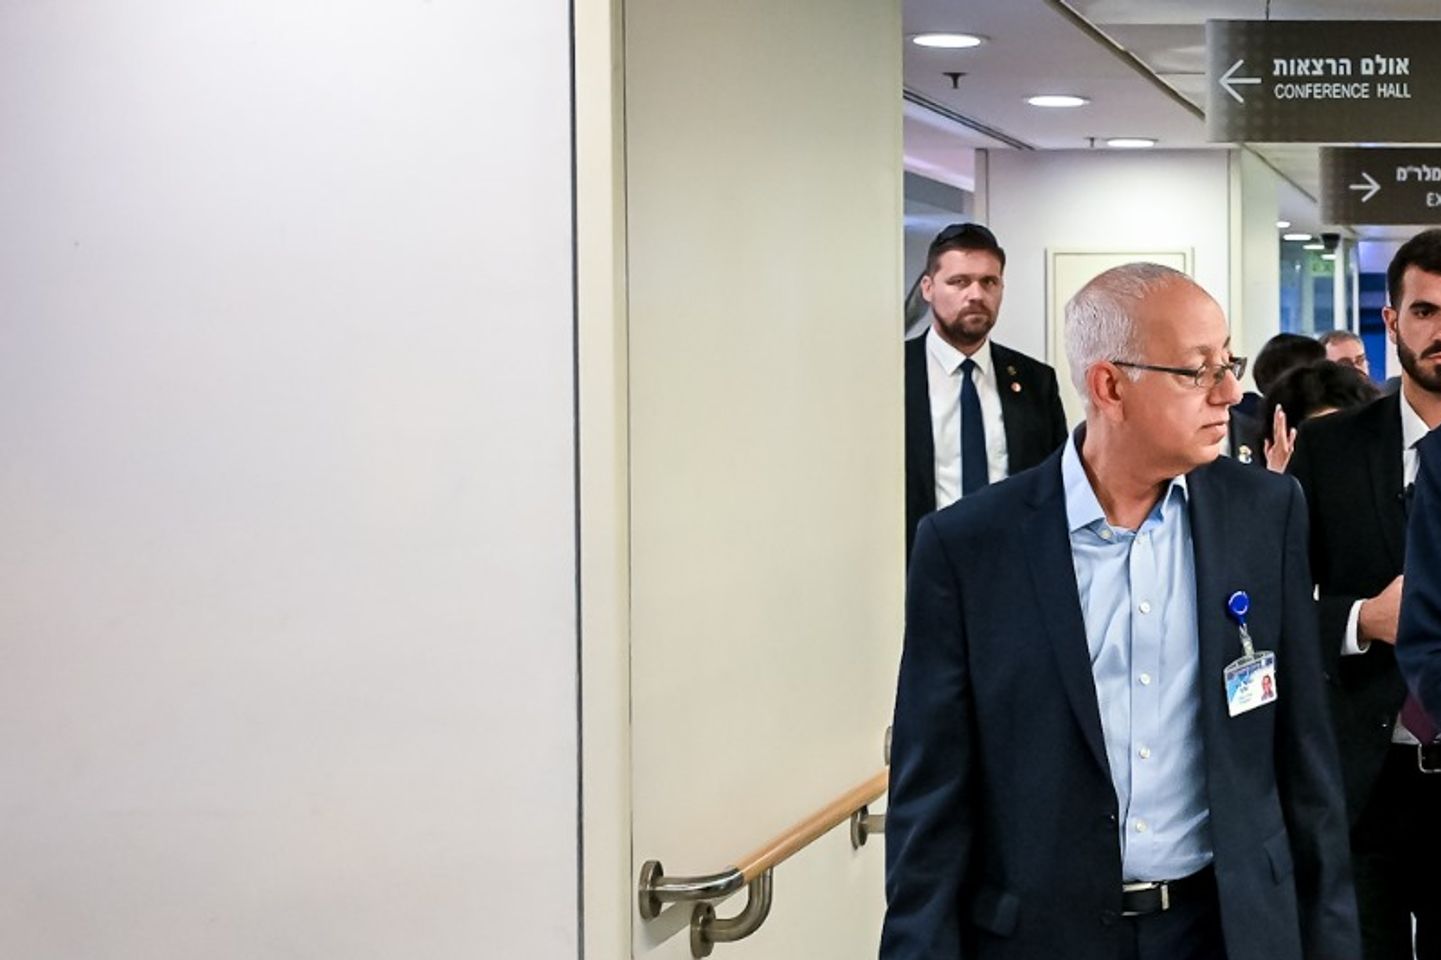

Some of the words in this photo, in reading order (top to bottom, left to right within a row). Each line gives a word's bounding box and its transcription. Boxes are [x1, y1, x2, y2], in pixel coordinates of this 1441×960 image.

[1272, 57, 1352, 76] הרצאות
[1360, 54, 1410, 76] אולם
[1273, 83, 1370, 99] CONFERENCE
[1376, 83, 1412, 98] HALL
